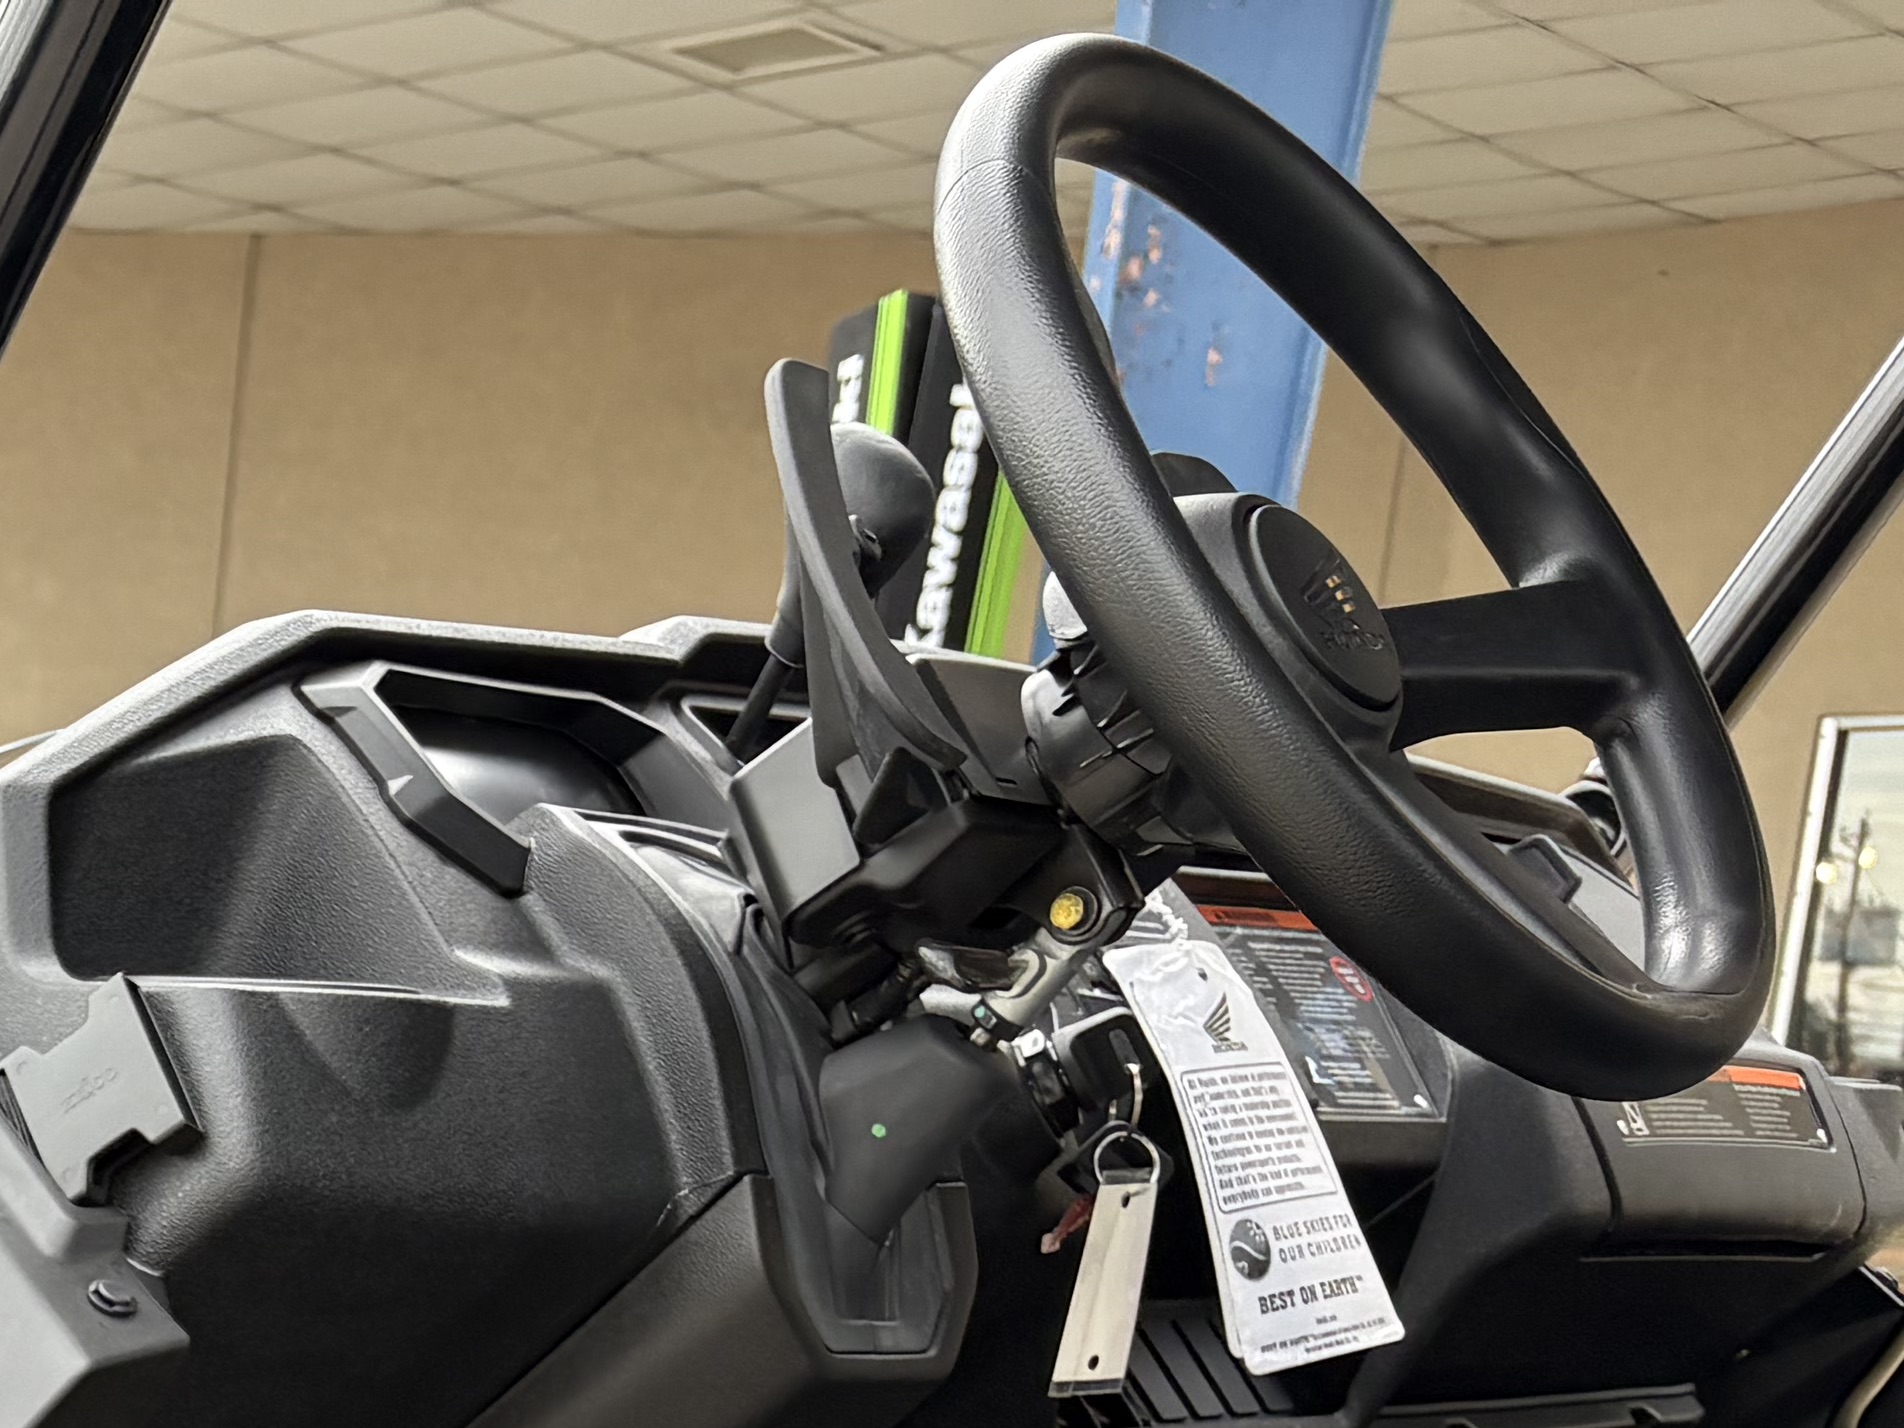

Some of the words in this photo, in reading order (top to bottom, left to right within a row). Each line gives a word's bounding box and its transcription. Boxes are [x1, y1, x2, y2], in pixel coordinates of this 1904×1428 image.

[1273, 1220, 1303, 1241] BLUE
[1303, 1216, 1334, 1235] SKIES
[1279, 1244, 1306, 1263] OUR
[1307, 1234, 1362, 1257] CHILDREN
[1258, 1288, 1295, 1315] BEST
[1299, 1281, 1319, 1305] ON
